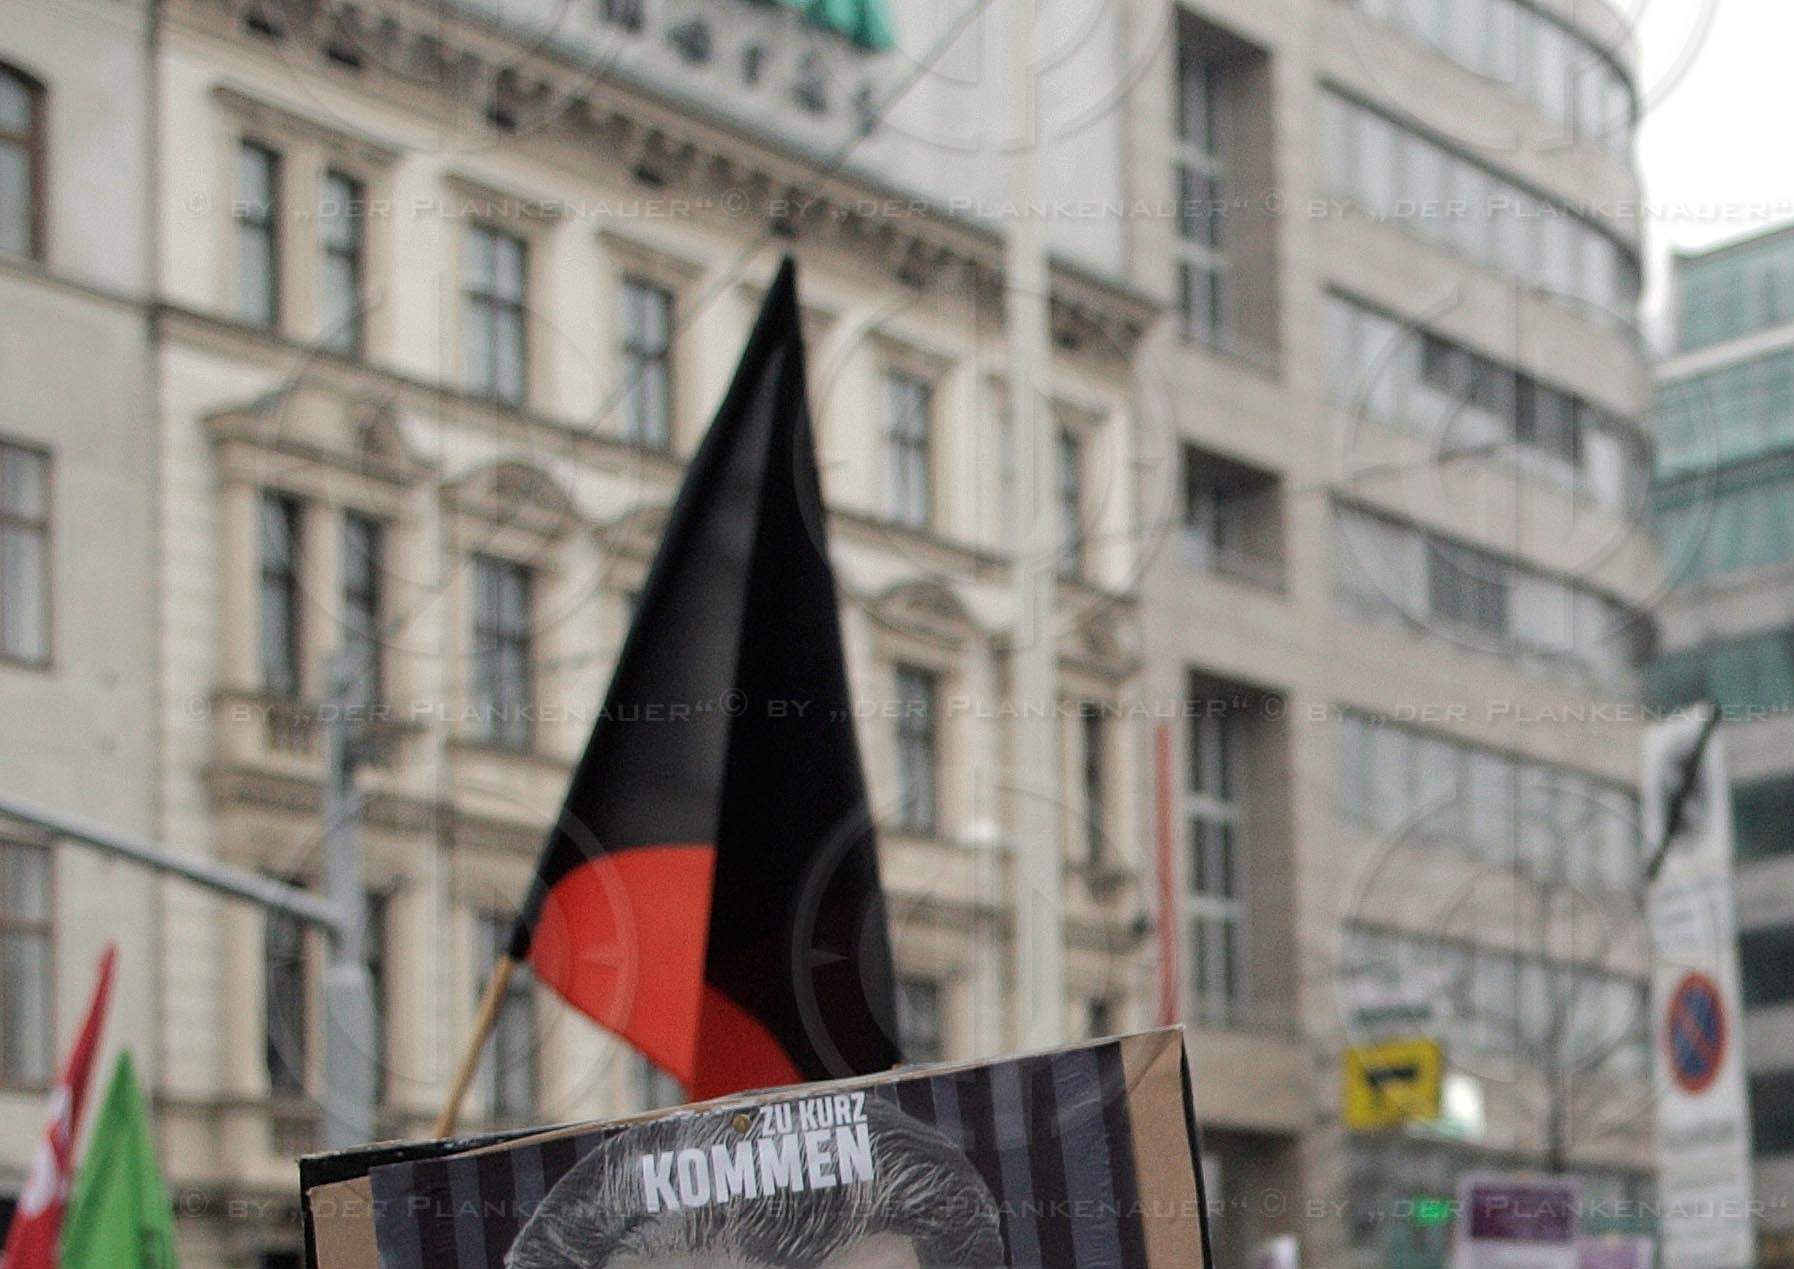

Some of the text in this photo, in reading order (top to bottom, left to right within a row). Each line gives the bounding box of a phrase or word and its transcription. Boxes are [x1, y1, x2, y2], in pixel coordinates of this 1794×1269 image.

[759, 1091, 868, 1137] ZU KURZ
[641, 1122, 875, 1213] KOMMEN
